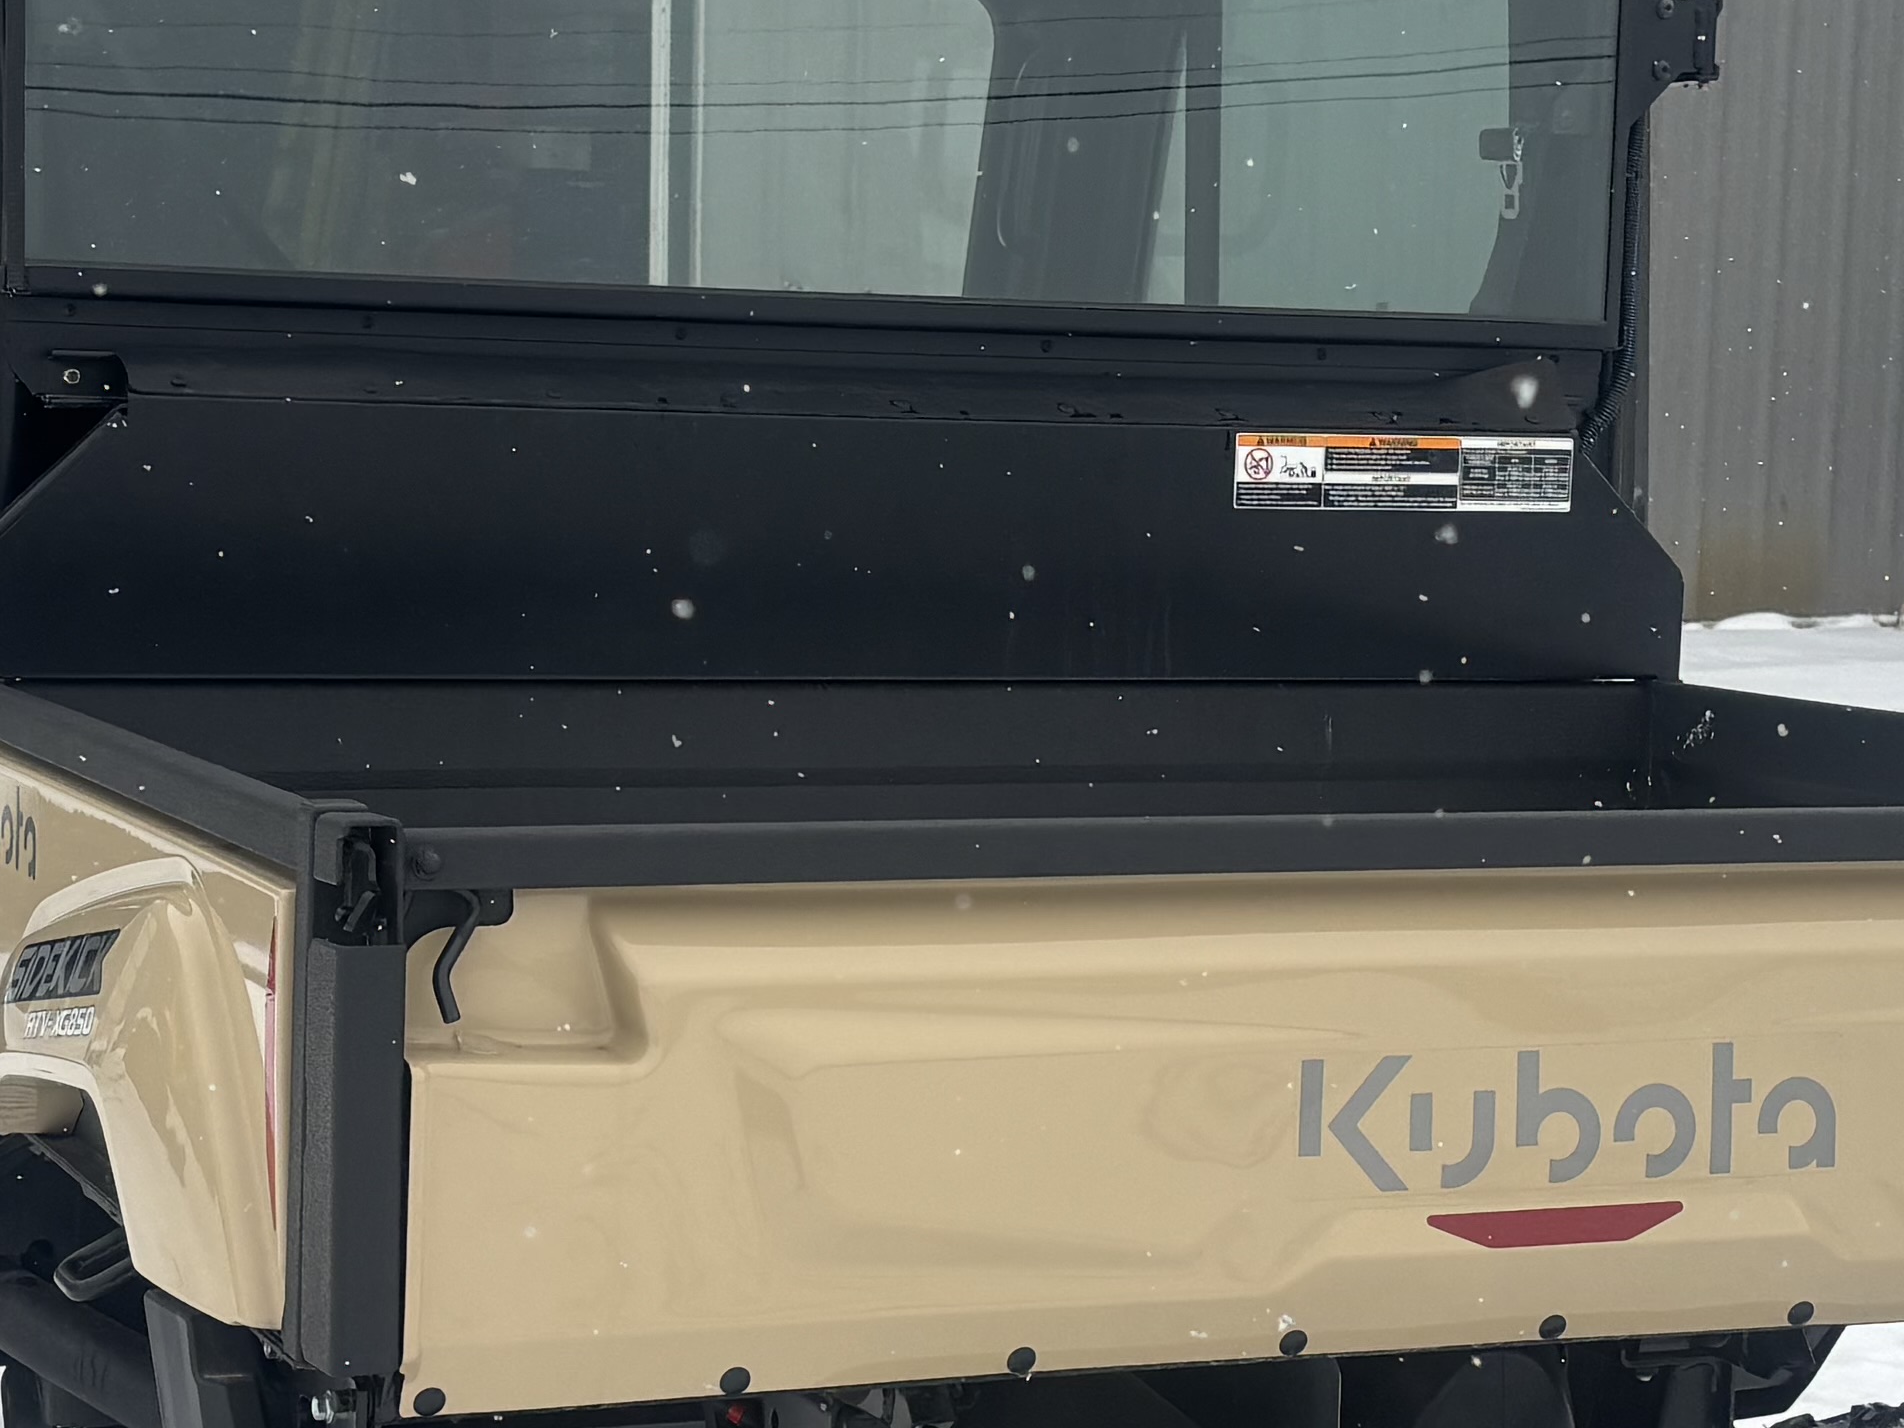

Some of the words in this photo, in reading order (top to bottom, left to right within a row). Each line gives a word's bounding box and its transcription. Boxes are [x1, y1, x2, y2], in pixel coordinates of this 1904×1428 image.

[7, 931, 117, 1002] SIDEKICK
[23, 1005, 95, 1039] RTV-XG850
[1297, 1041, 1837, 1193] Kubota
